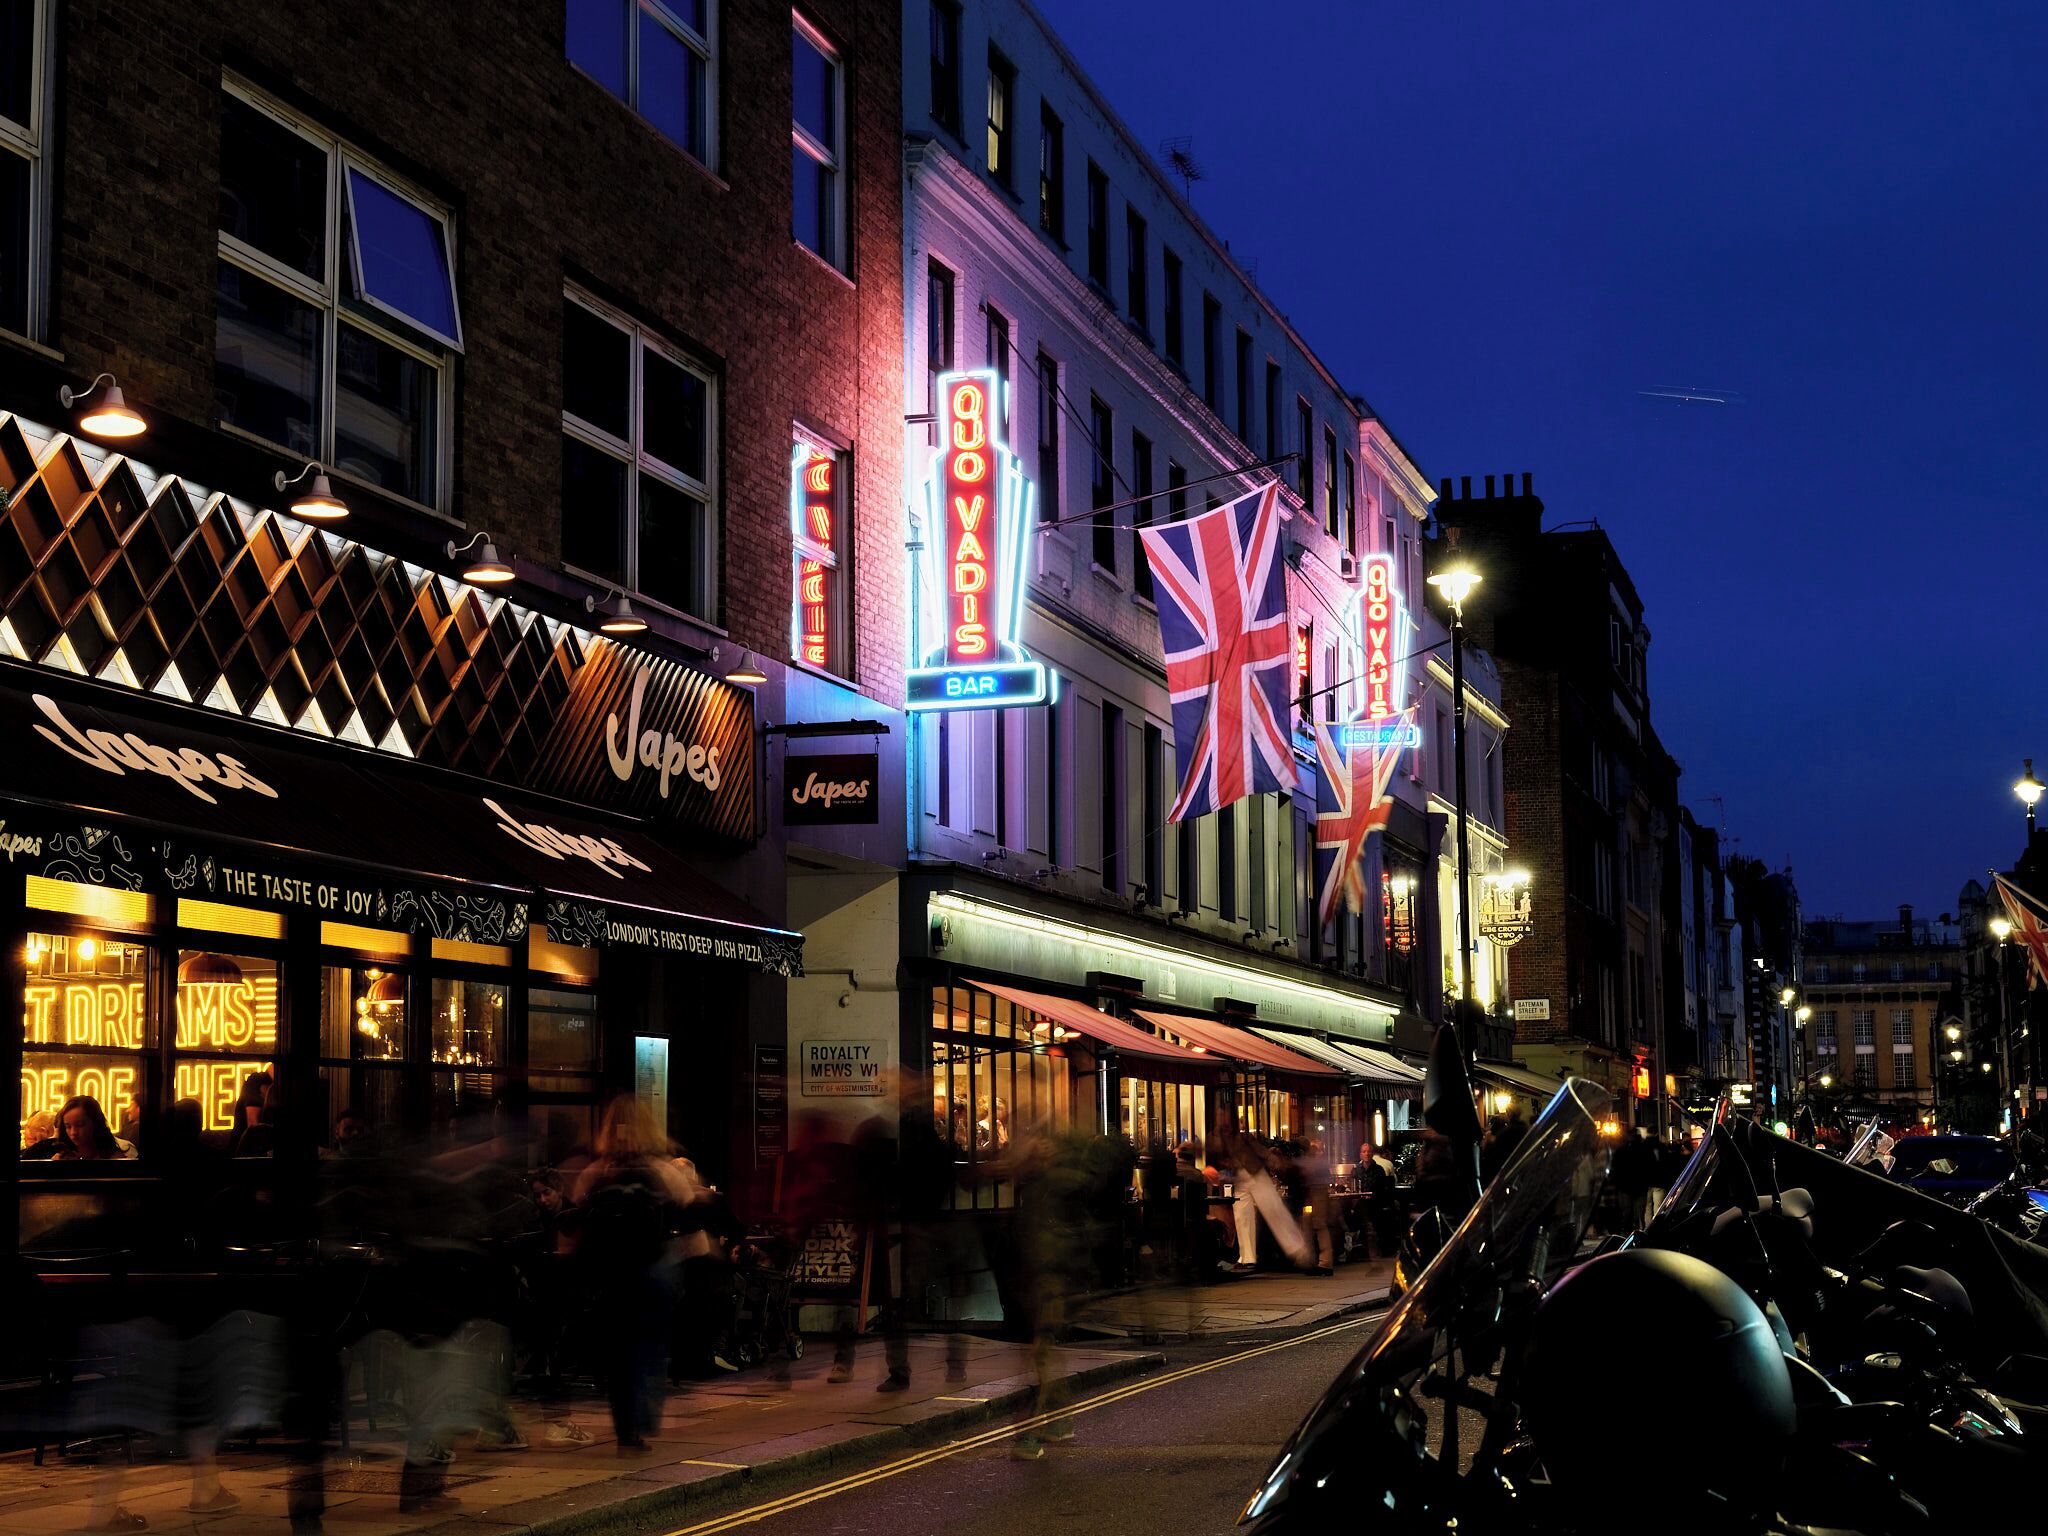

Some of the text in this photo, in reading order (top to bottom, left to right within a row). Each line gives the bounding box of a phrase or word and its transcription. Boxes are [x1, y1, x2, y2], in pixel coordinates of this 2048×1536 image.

[953, 384, 986, 655] QUO VADIS
[1369, 564, 1389, 719] QUO VADIS
[946, 676, 996, 697] BAR
[32, 694, 279, 804] Japes
[606, 664, 721, 798] Japes
[1346, 730, 1413, 741] RESTURAT
[792, 771, 870, 808] Japes
[482, 797, 652, 880] Japes
[222, 867, 373, 916] THE TASTE OF JOY
[606, 921, 764, 963] LONDON'S FIRST DEEP DISH PIZZA
[23, 987, 56, 1045] T
[810, 1046, 871, 1060] ROYALTY
[811, 1063, 878, 1077] MEWS W1
[835, 1084, 880, 1092] WESTMINSTER
[805, 1239, 851, 1251] ORK
